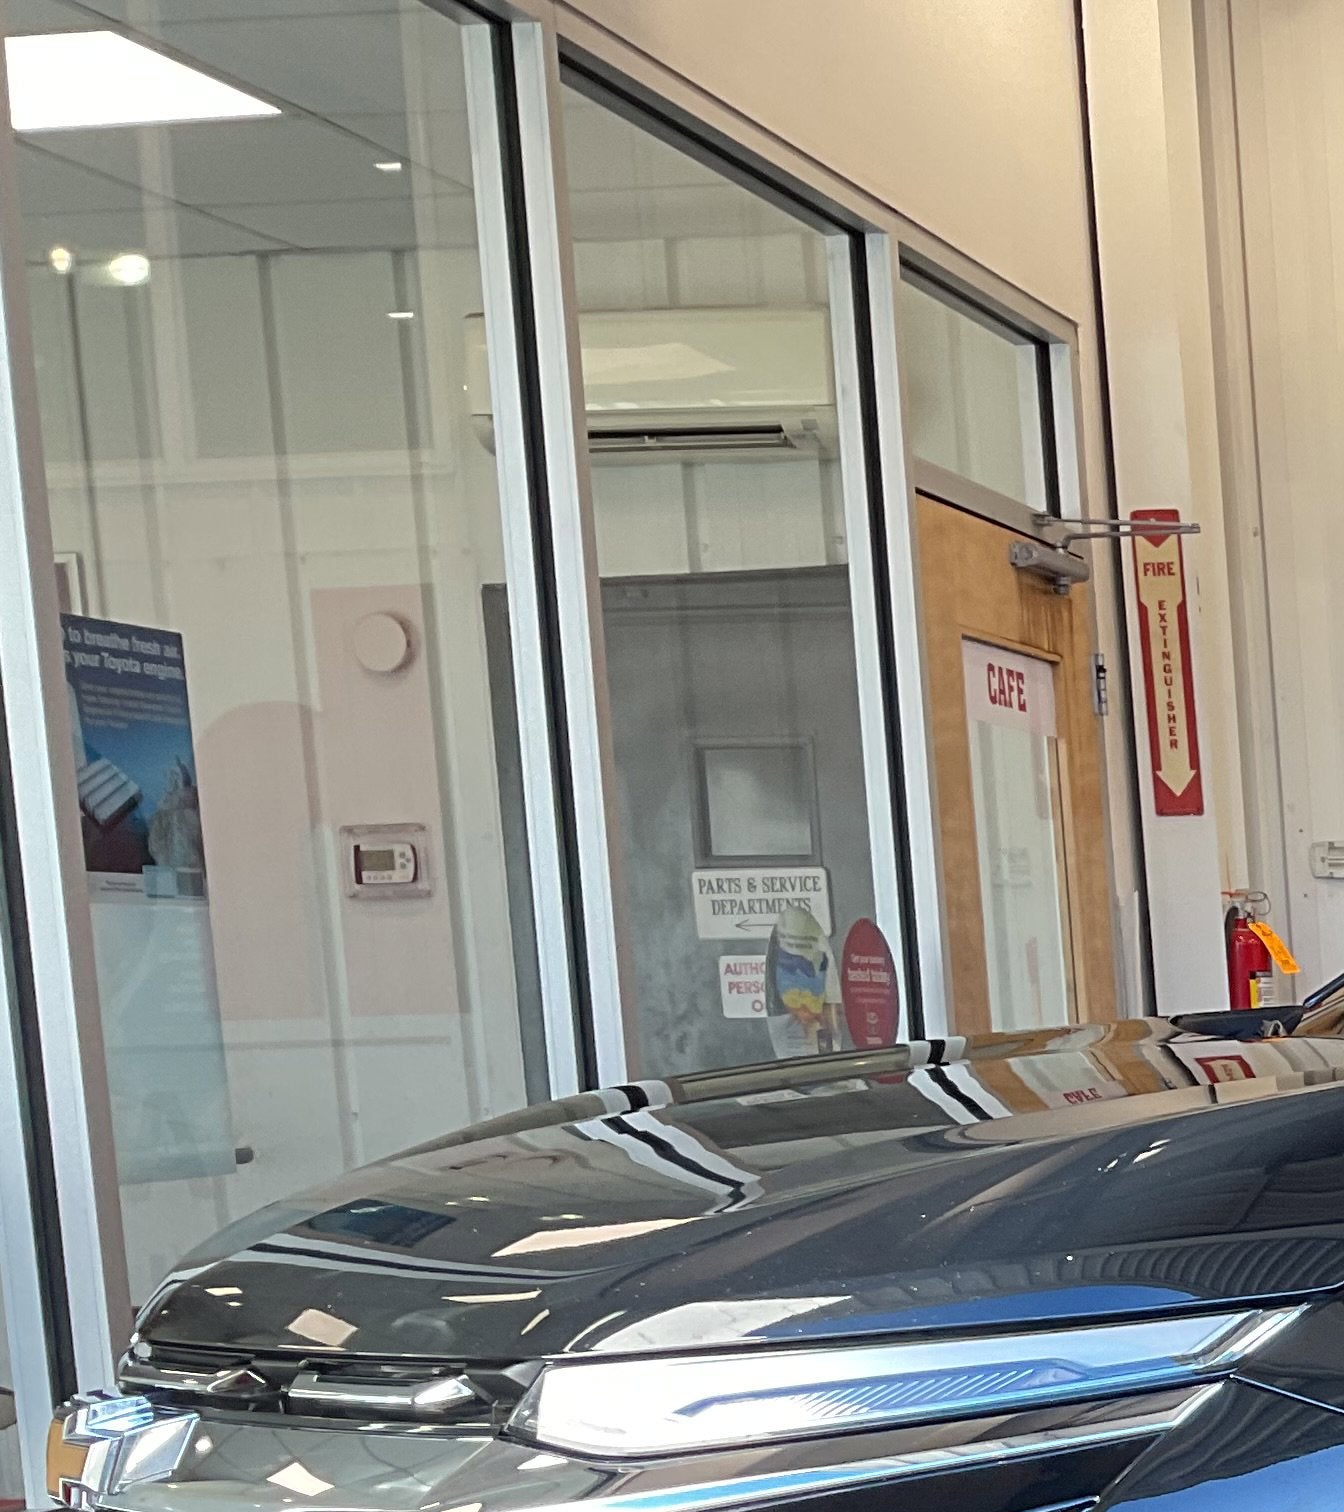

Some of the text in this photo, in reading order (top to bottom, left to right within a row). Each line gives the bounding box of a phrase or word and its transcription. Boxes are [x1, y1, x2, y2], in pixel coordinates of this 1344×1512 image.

[1143, 562, 1176, 577] FIRE
[101, 652, 141, 674] Toyota
[1157, 600, 1179, 749] EXTINGUISHER
[986, 662, 1027, 712] CAFE
[697, 875, 822, 895] PARTS & SERVICE
